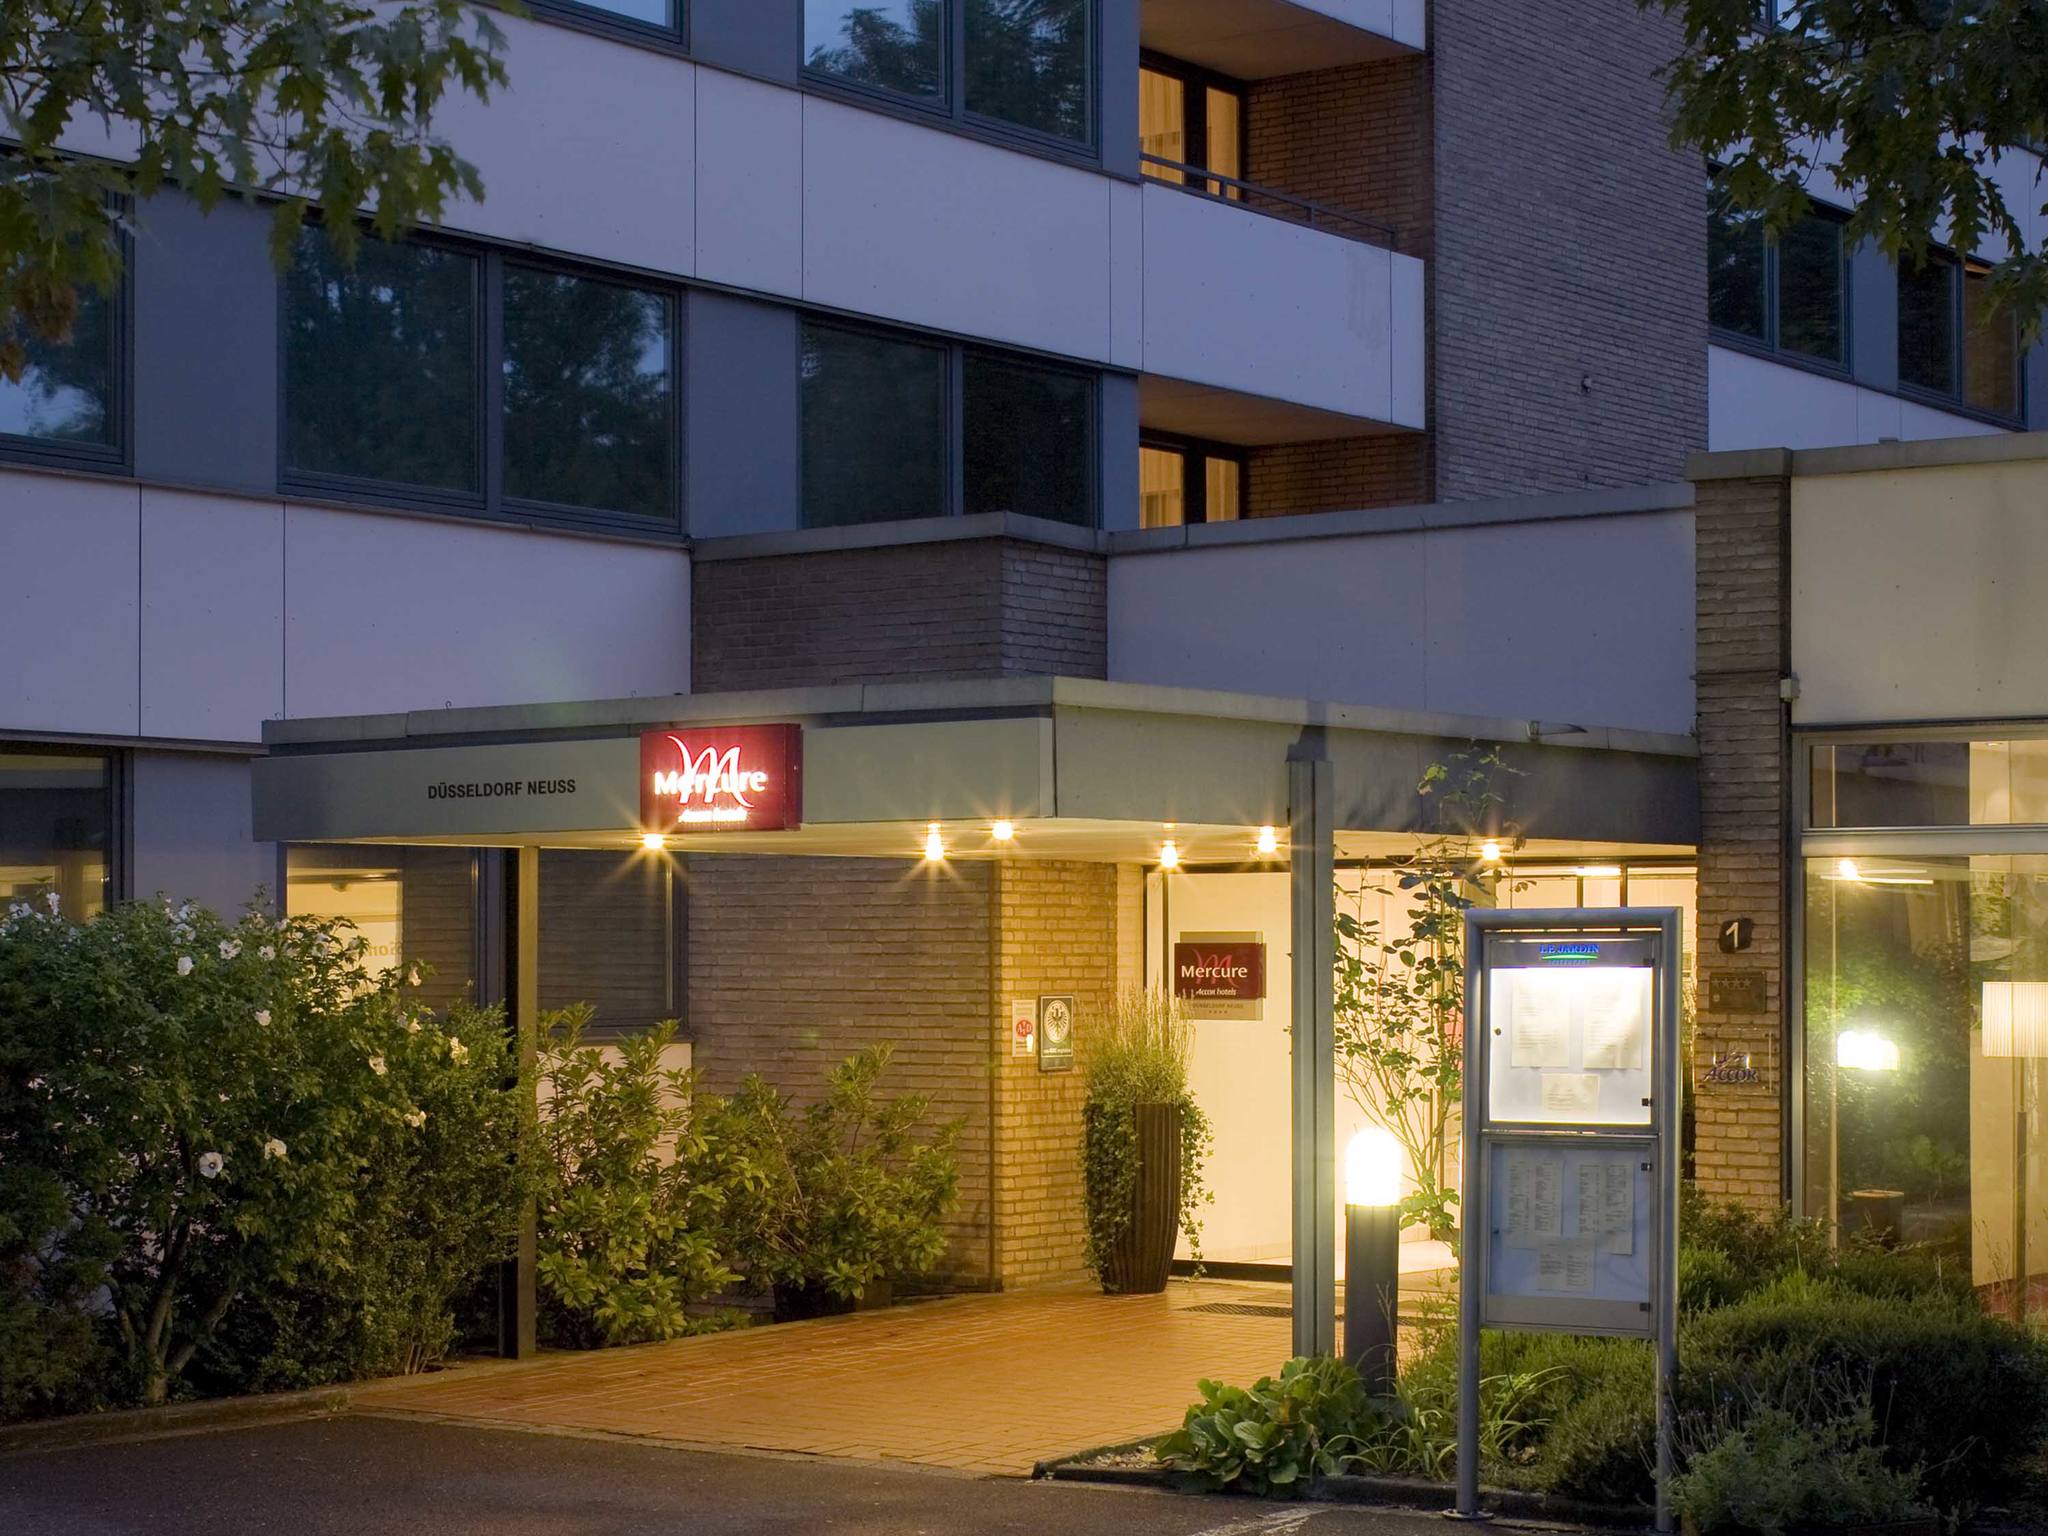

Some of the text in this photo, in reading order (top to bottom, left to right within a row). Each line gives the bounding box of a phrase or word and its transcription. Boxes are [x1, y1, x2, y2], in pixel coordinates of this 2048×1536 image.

[428, 779, 577, 799] DÜSSELDORF NEUSS
[654, 769, 768, 796] Mercure
[1725, 922, 1739, 949] 1
[1557, 943, 1599, 954] JARDIN
[1181, 965, 1248, 978] Mercure
[1703, 1067, 1758, 1083] ACCOR
